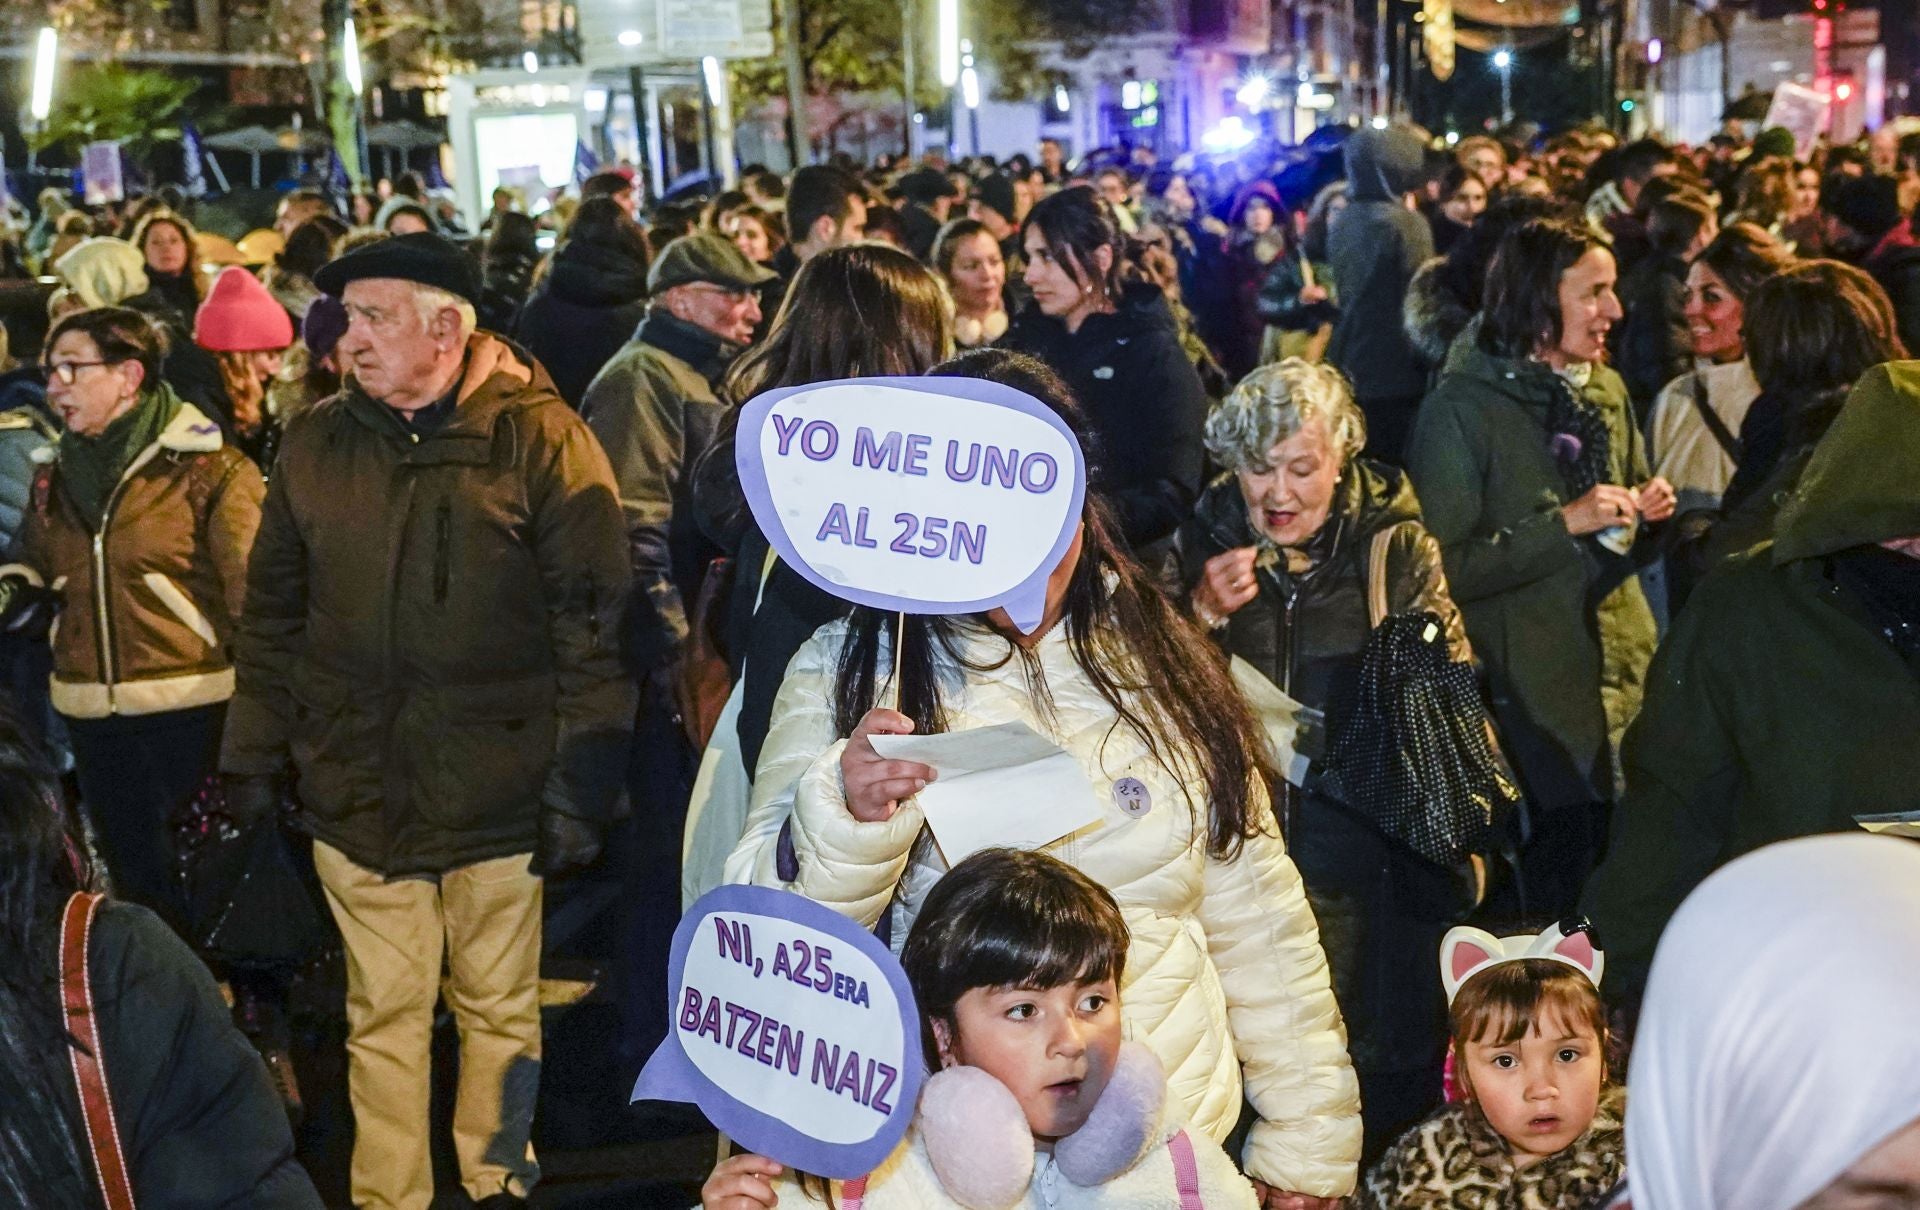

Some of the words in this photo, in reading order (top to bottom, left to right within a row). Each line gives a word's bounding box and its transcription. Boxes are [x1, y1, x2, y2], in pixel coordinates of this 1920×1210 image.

[772, 414, 839, 462] YO
[852, 426, 932, 476] ME
[945, 439, 1059, 494] UNO
[815, 502, 878, 549] AL
[889, 512, 988, 565] 25N
[713, 916, 765, 978] NI,
[772, 939, 871, 1009] A25ERA
[679, 986, 805, 1077] BATZEN
[810, 1038, 899, 1116] NAIZ
